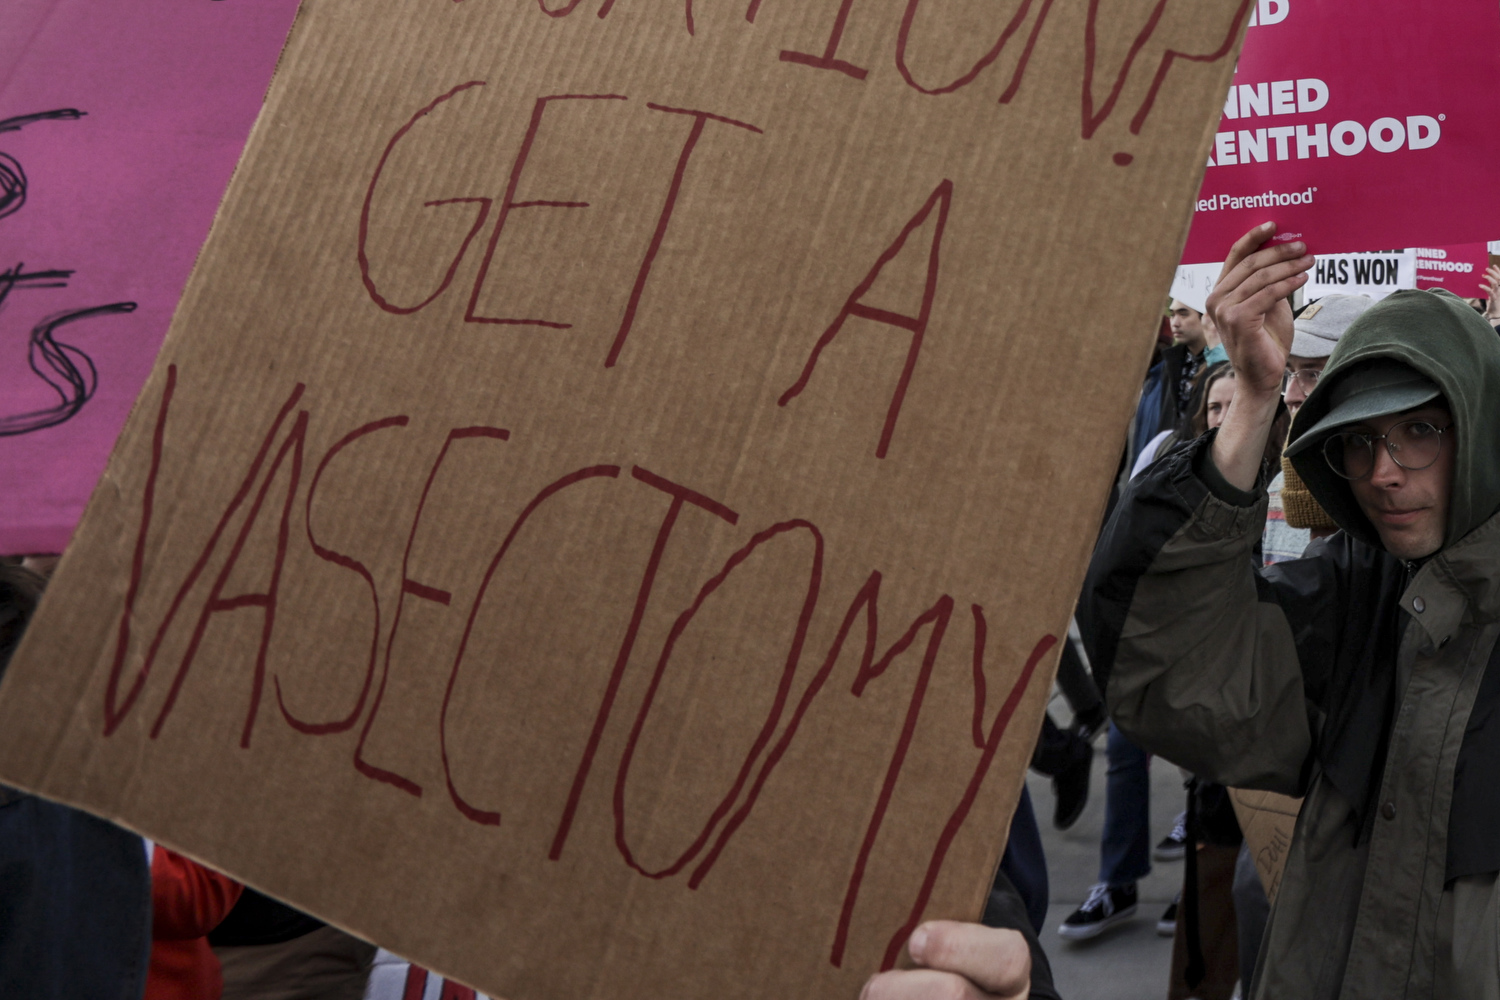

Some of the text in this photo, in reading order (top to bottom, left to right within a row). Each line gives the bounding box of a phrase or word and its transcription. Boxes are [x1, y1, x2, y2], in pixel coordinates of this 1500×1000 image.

[358, 81, 763, 367] GET
[777, 178, 953, 459] A
[1315, 258, 1399, 285] HAS WON
[104, 364, 1058, 972] VASECTOMY
